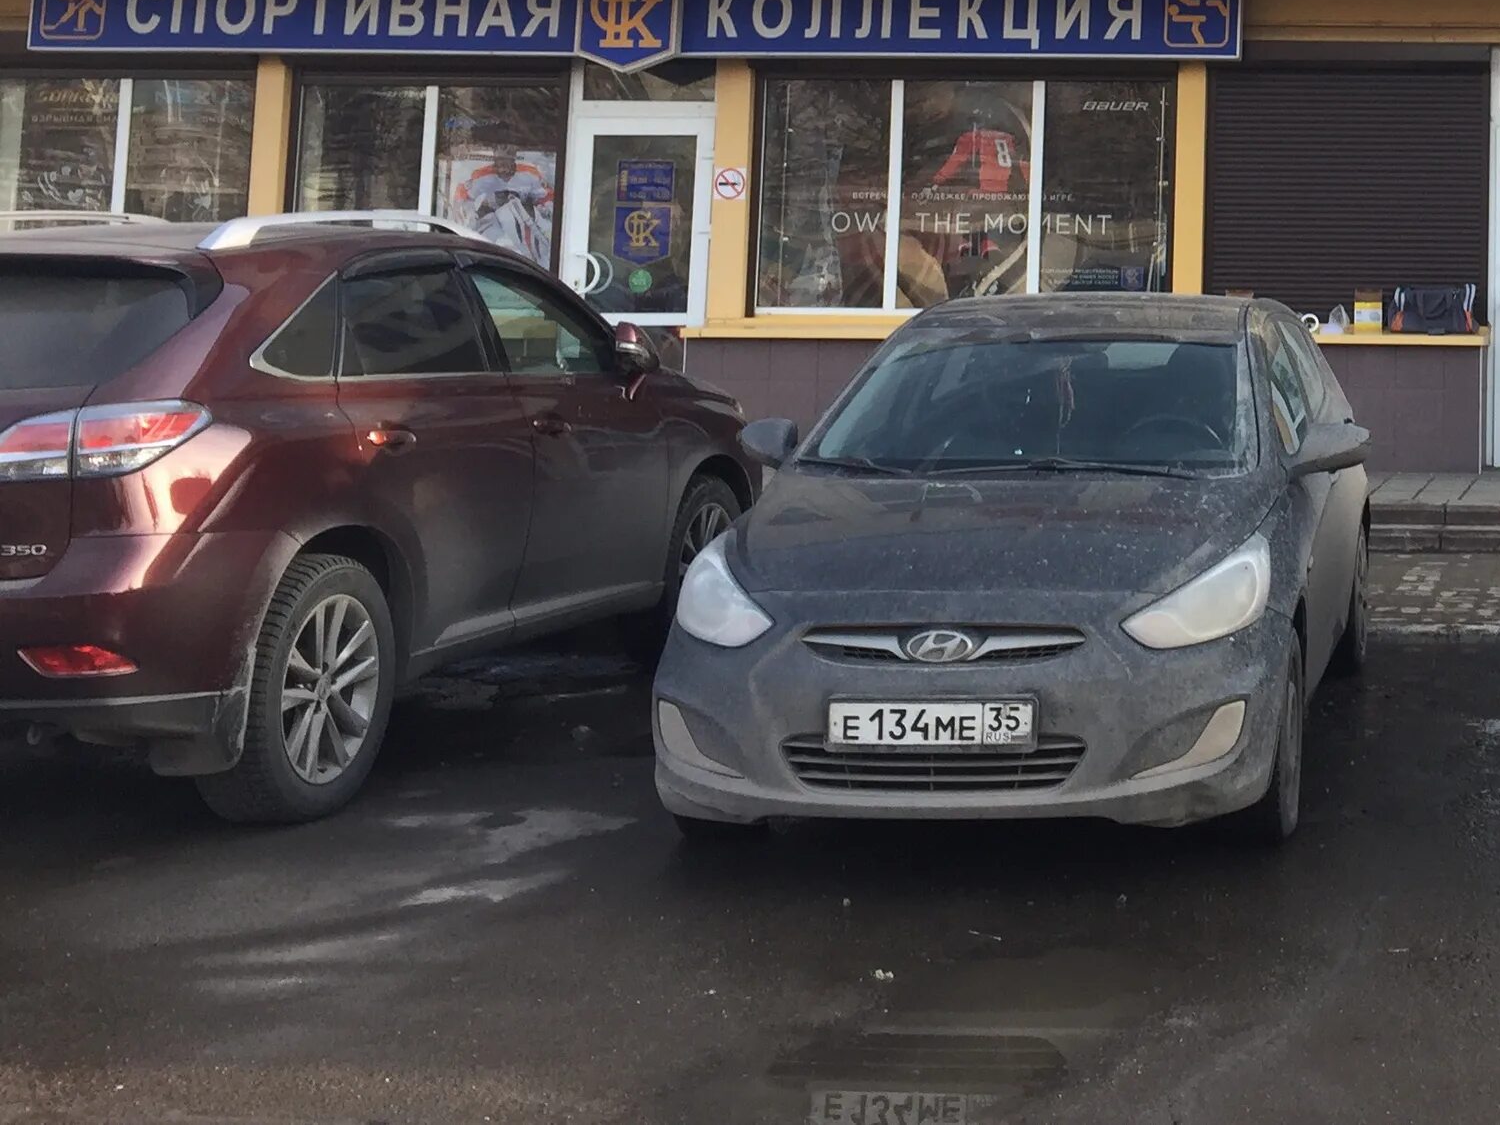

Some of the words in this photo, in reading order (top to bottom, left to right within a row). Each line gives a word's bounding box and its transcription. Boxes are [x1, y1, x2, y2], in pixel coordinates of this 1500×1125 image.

[1082, 100, 1149, 112] BAUER
[831, 211, 889, 234] OW
[915, 212, 972, 234] THE
[1, 544, 47, 556] 350
[987, 706, 1020, 732] 35
[985, 732, 1011, 743] RUS
